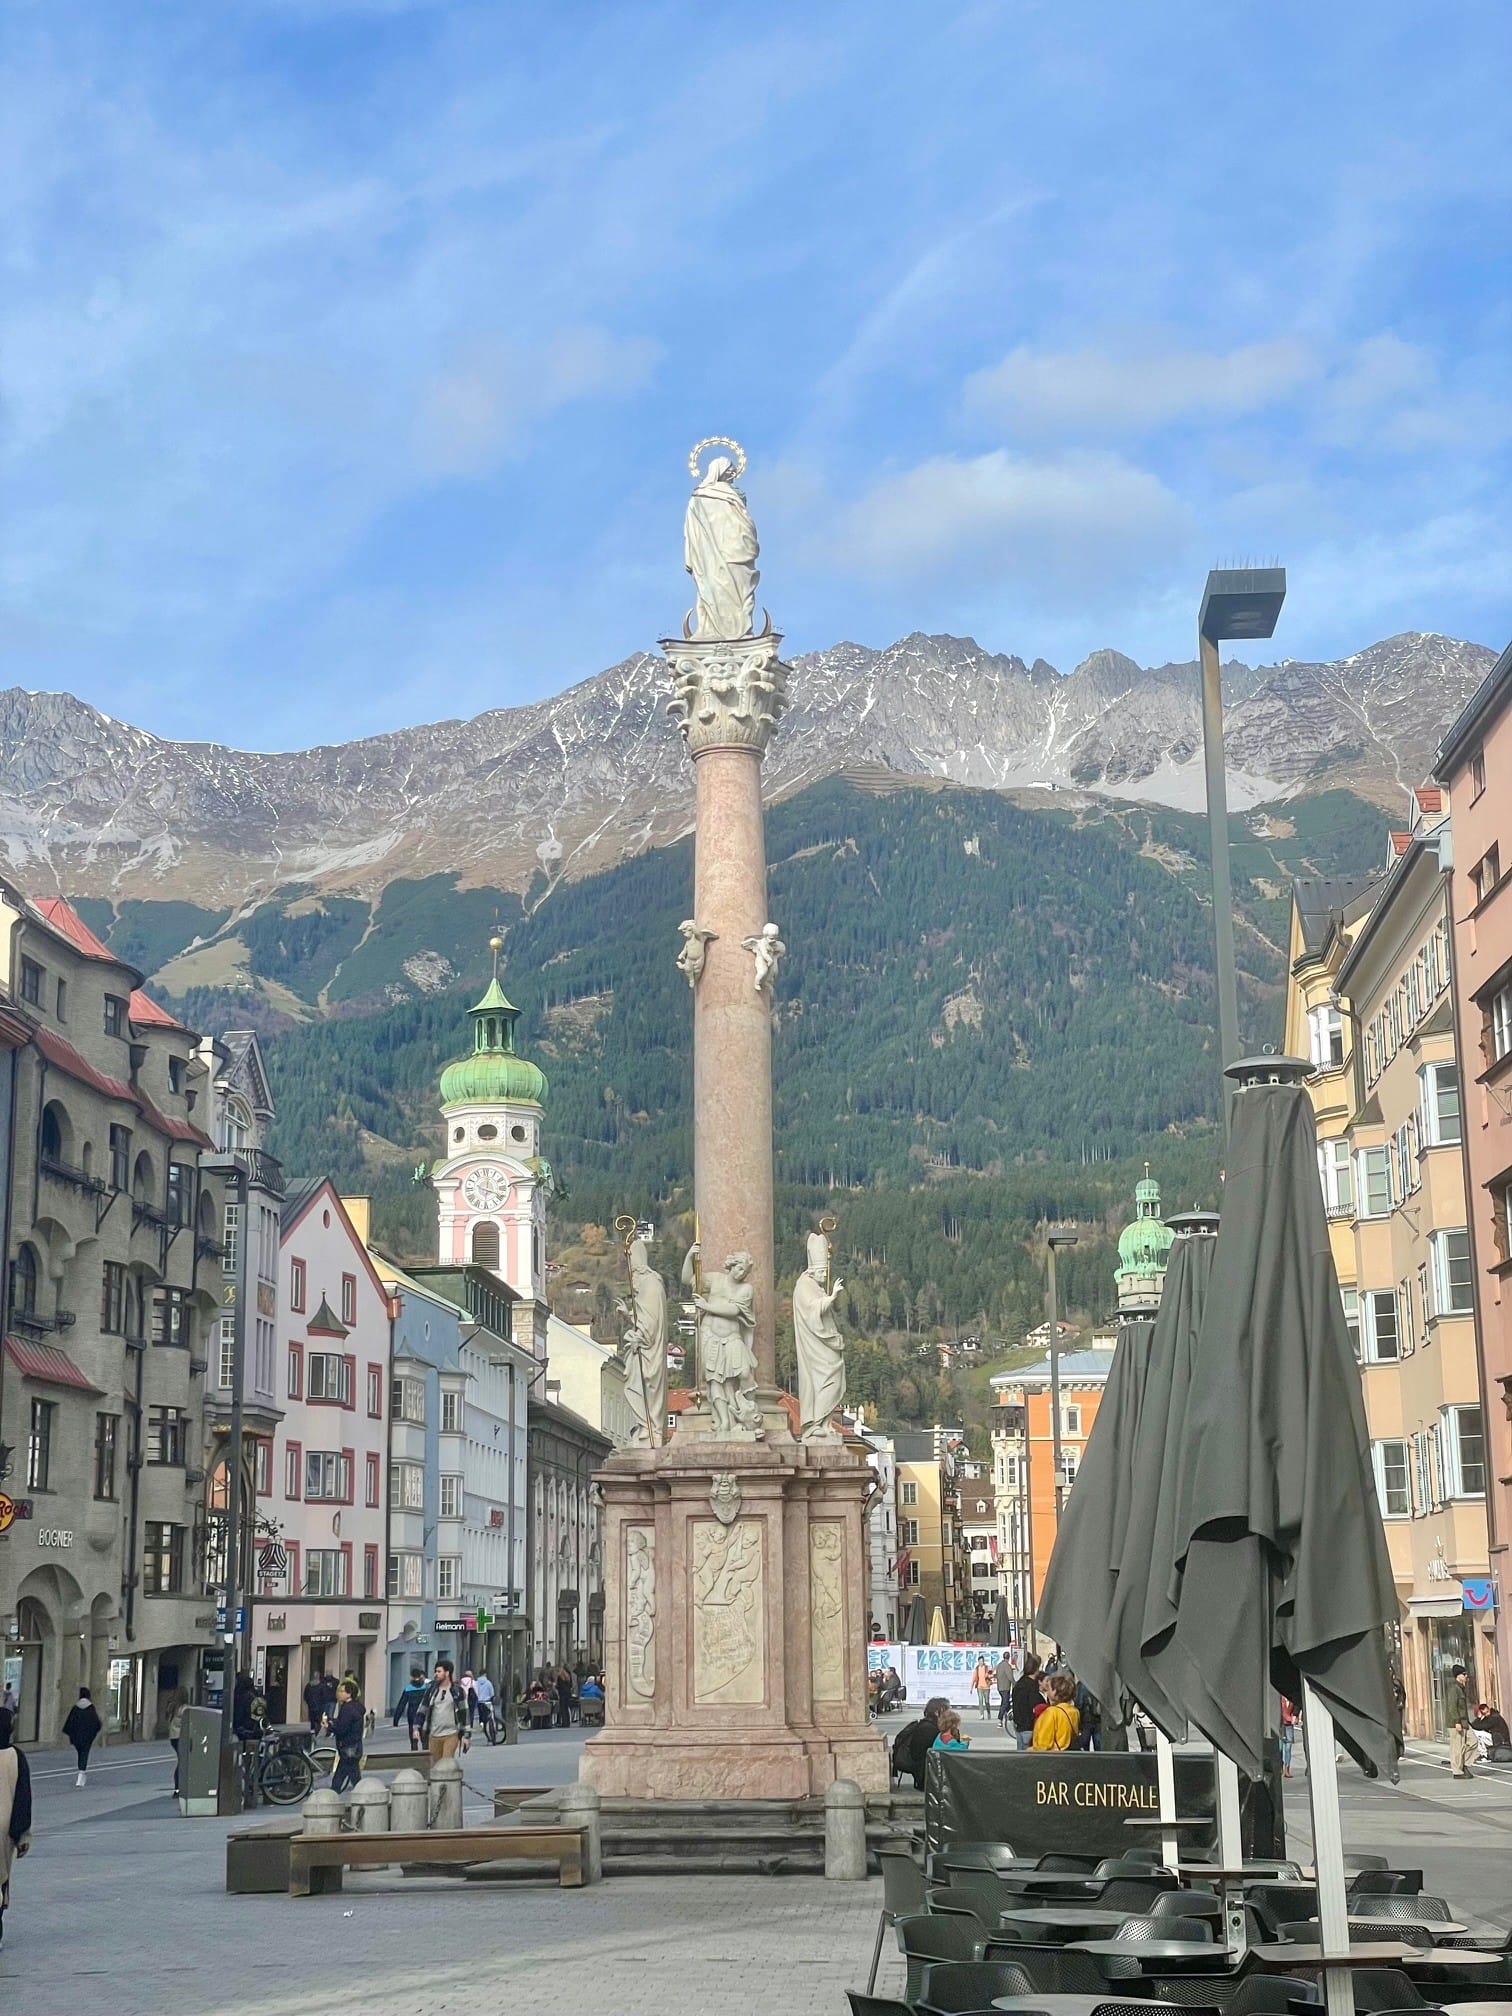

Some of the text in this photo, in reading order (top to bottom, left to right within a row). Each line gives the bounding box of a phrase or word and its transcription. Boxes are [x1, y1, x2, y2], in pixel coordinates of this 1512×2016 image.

[38, 1528, 73, 1548] BOGNER
[1036, 1781, 1158, 1808] BAR CENTRALE
